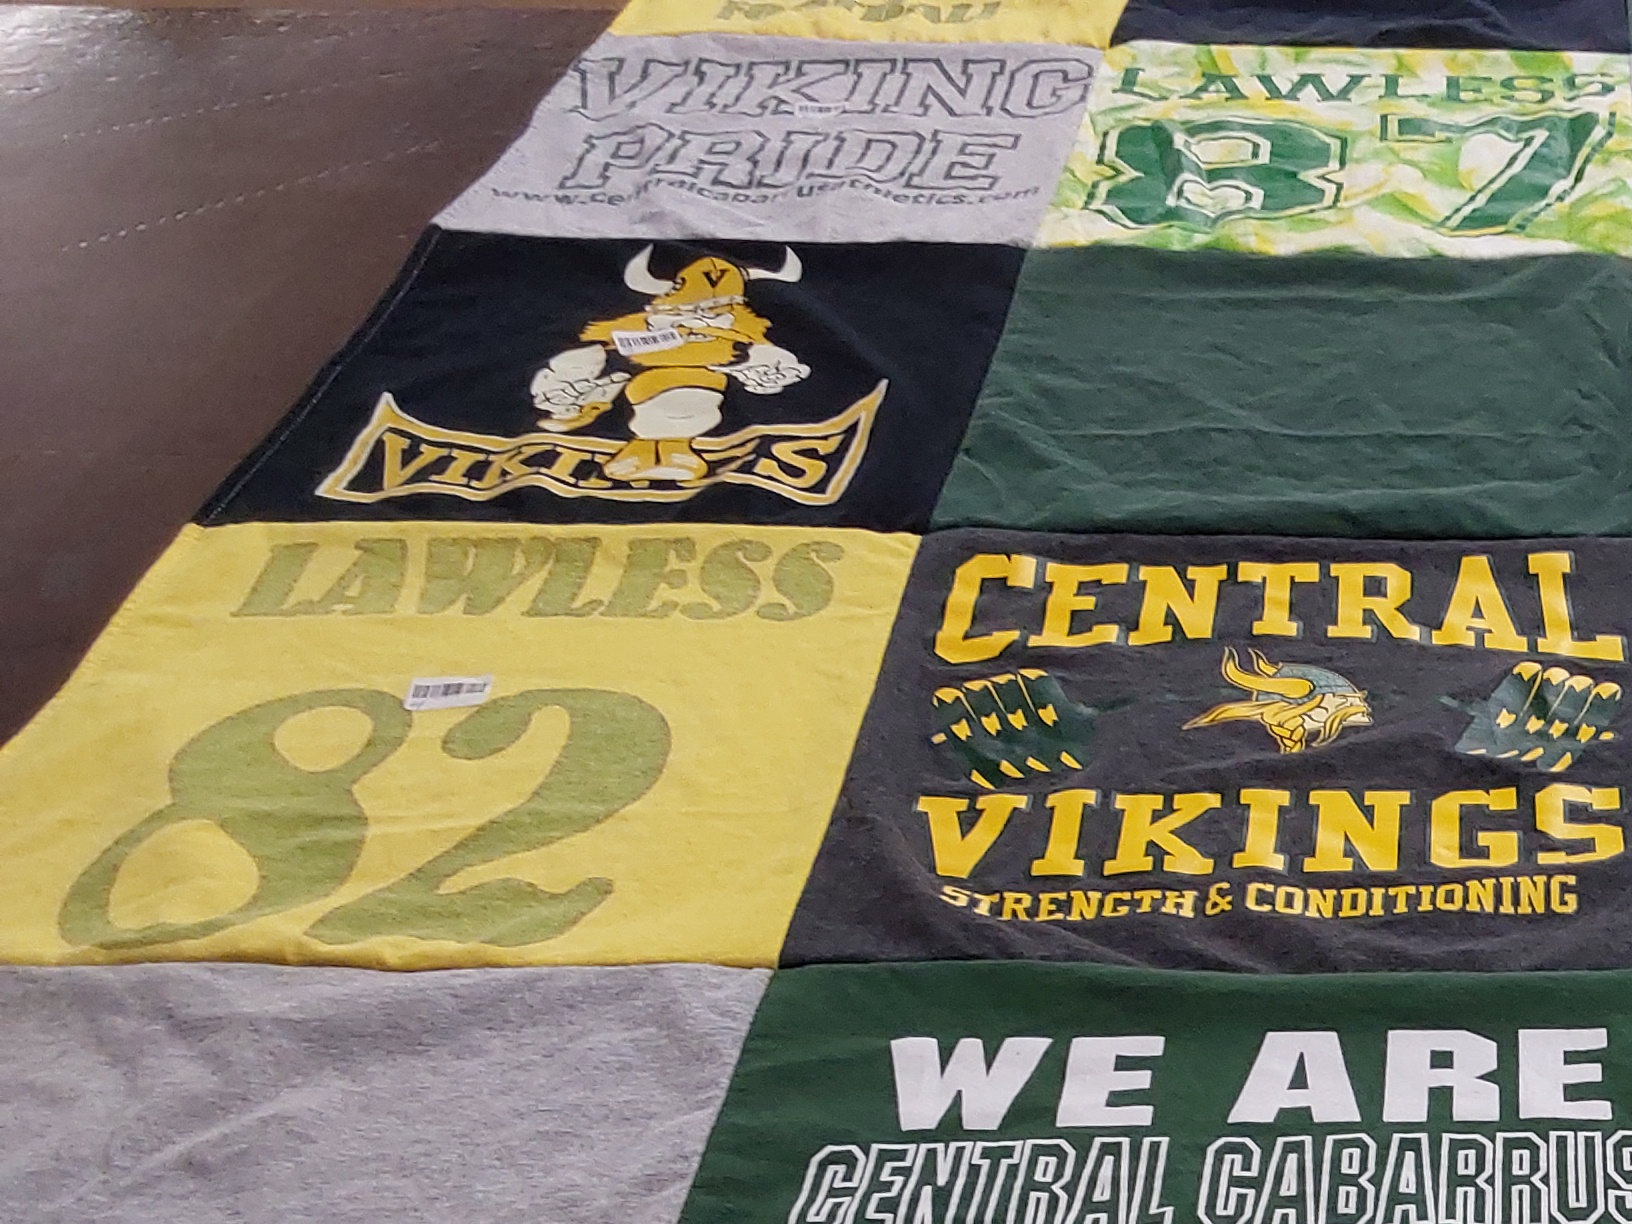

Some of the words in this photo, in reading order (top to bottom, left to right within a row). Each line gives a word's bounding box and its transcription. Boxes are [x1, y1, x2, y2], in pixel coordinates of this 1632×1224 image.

[567, 57, 1095, 121] VIKING
[1111, 66, 1616, 102] LAWLESS
[558, 122, 1022, 190] PRIDE
[380, 431, 845, 491] VIKIS
[231, 536, 845, 622] LAWLESS
[932, 550, 1628, 665] CENTRAL
[57, 687, 673, 951] 82
[915, 781, 1627, 879] VIKINGS
[940, 884, 1199, 923] STRENGTH
[1204, 880, 1233, 915] &
[1245, 873, 1580, 919] CONDITIONING
[889, 1033, 1166, 1132] WE
[1226, 1027, 1614, 1125] ARE
